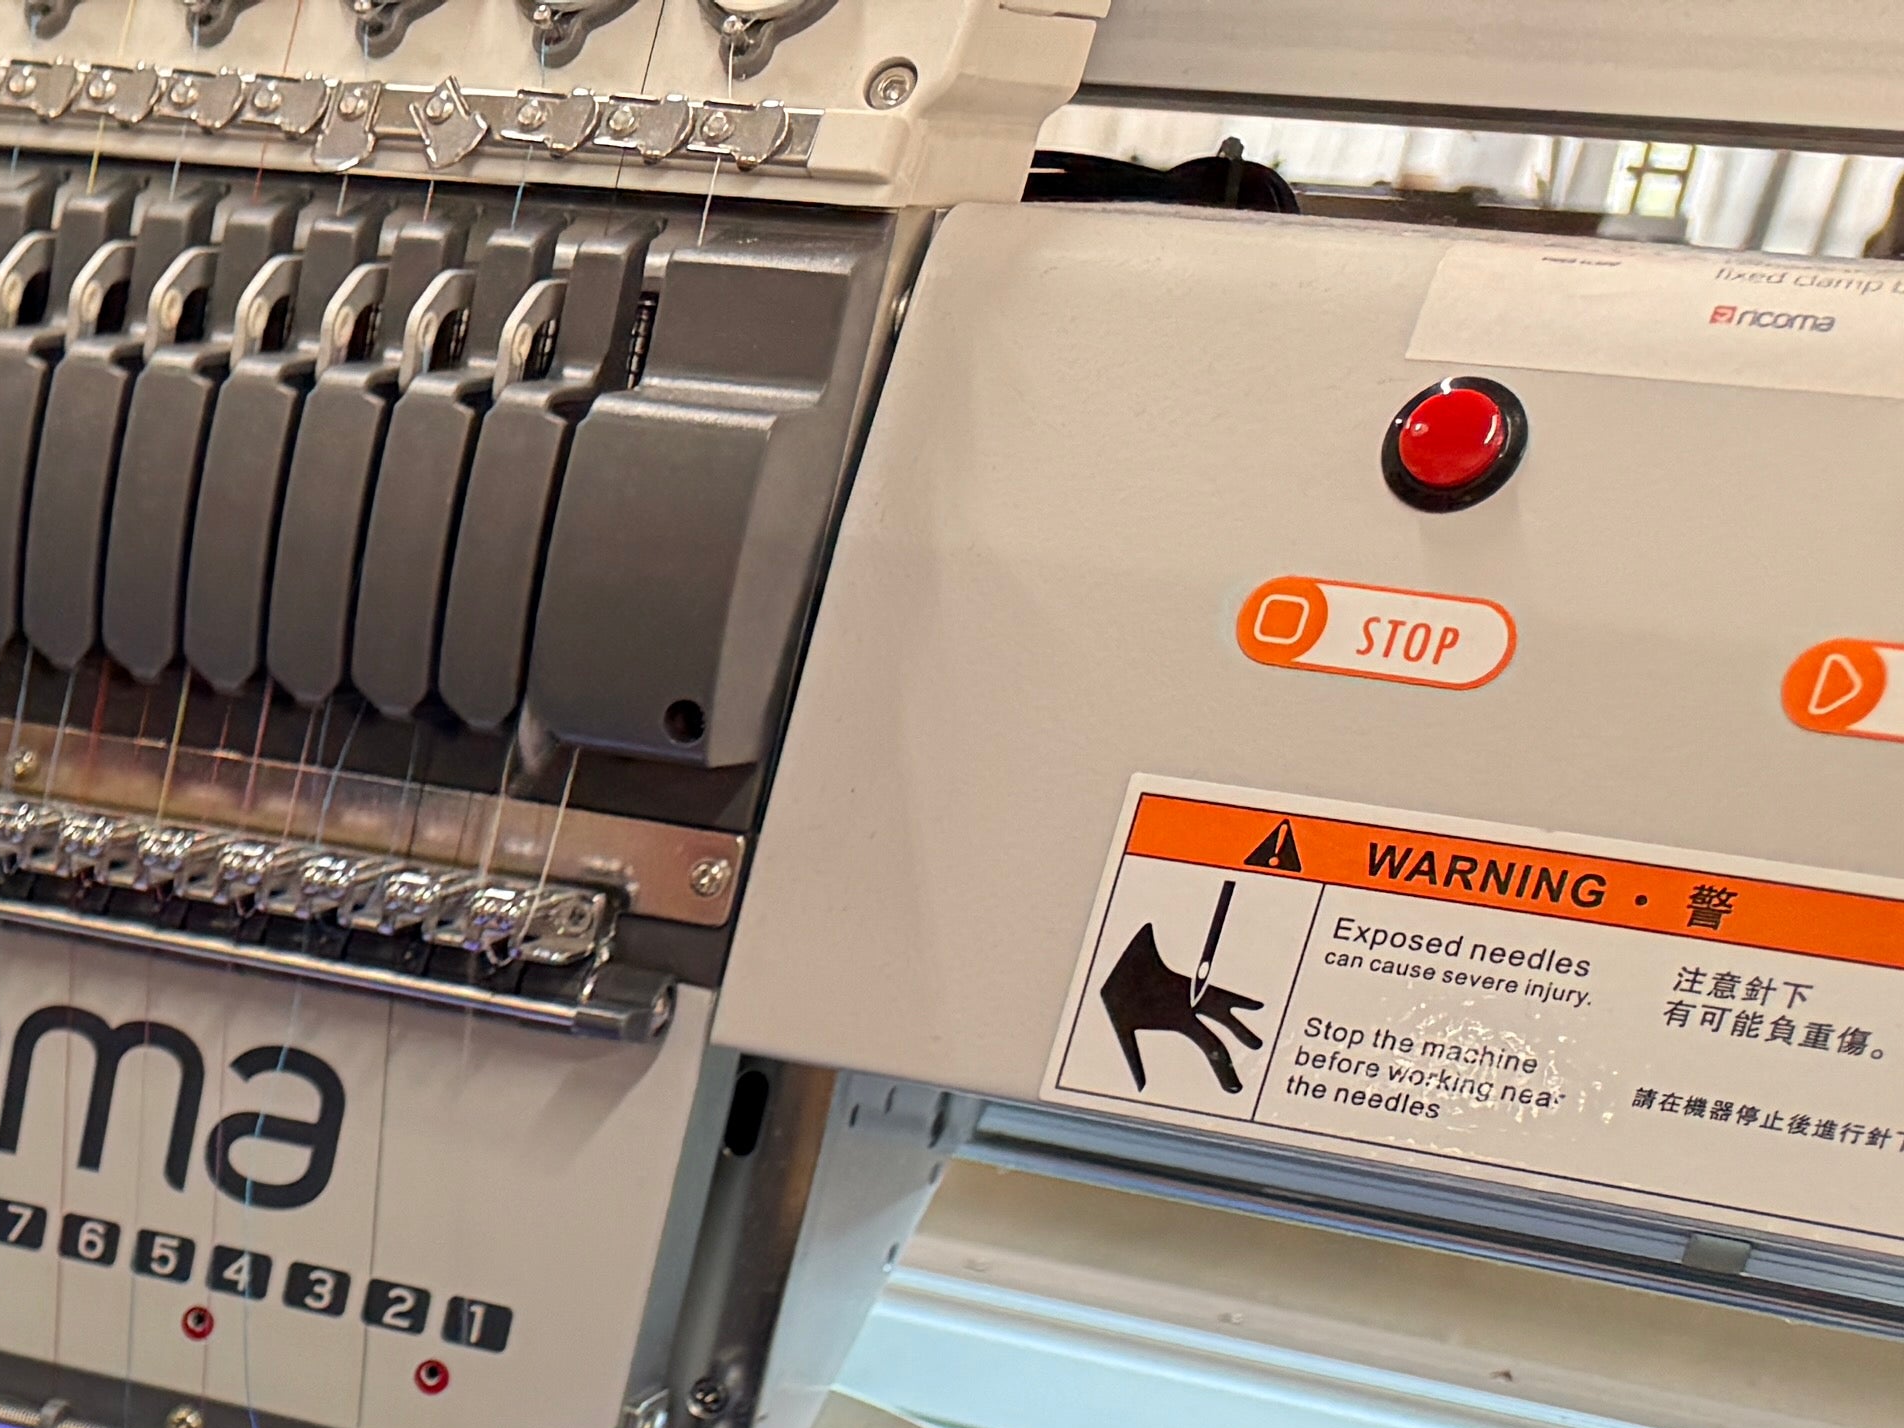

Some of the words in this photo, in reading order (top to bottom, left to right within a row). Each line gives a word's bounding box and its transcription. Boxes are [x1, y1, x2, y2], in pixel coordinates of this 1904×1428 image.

[1715, 267, 1789, 285] fixed
[1793, 271, 1884, 296] clamp
[1736, 308, 1837, 333] ricoma
[1355, 616, 1460, 665] STOP
[1367, 842, 1609, 909] WARNING
[1686, 884, 1738, 931] 警
[1333, 917, 1464, 959] Exposed
[1469, 946, 1591, 978] needles
[1324, 950, 1364, 969] can
[1369, 959, 1436, 981] cause
[1442, 969, 1519, 994] severe
[1524, 979, 1593, 1009] injury.
[1672, 965, 1815, 1010] 注意針下
[1303, 1016, 1365, 1050] Stop
[1372, 1027, 1414, 1054] the
[1421, 1038, 1538, 1075] machine
[1662, 999, 1886, 1062] 有可能負重傷。
[1286, 1075, 1328, 1100] the
[1334, 1086, 1442, 1120] needles
[1294, 1044, 1382, 1080] before
[1388, 1063, 1495, 1102] working
[6, 1204, 34, 1244] 7
[76, 1220, 106, 1261] 6
[149, 1235, 181, 1277] 5
[221, 1251, 252, 1293] 4
[302, 1269, 336, 1311] 3
[380, 1287, 413, 1330] 2
[466, 1302, 485, 1345] 1
